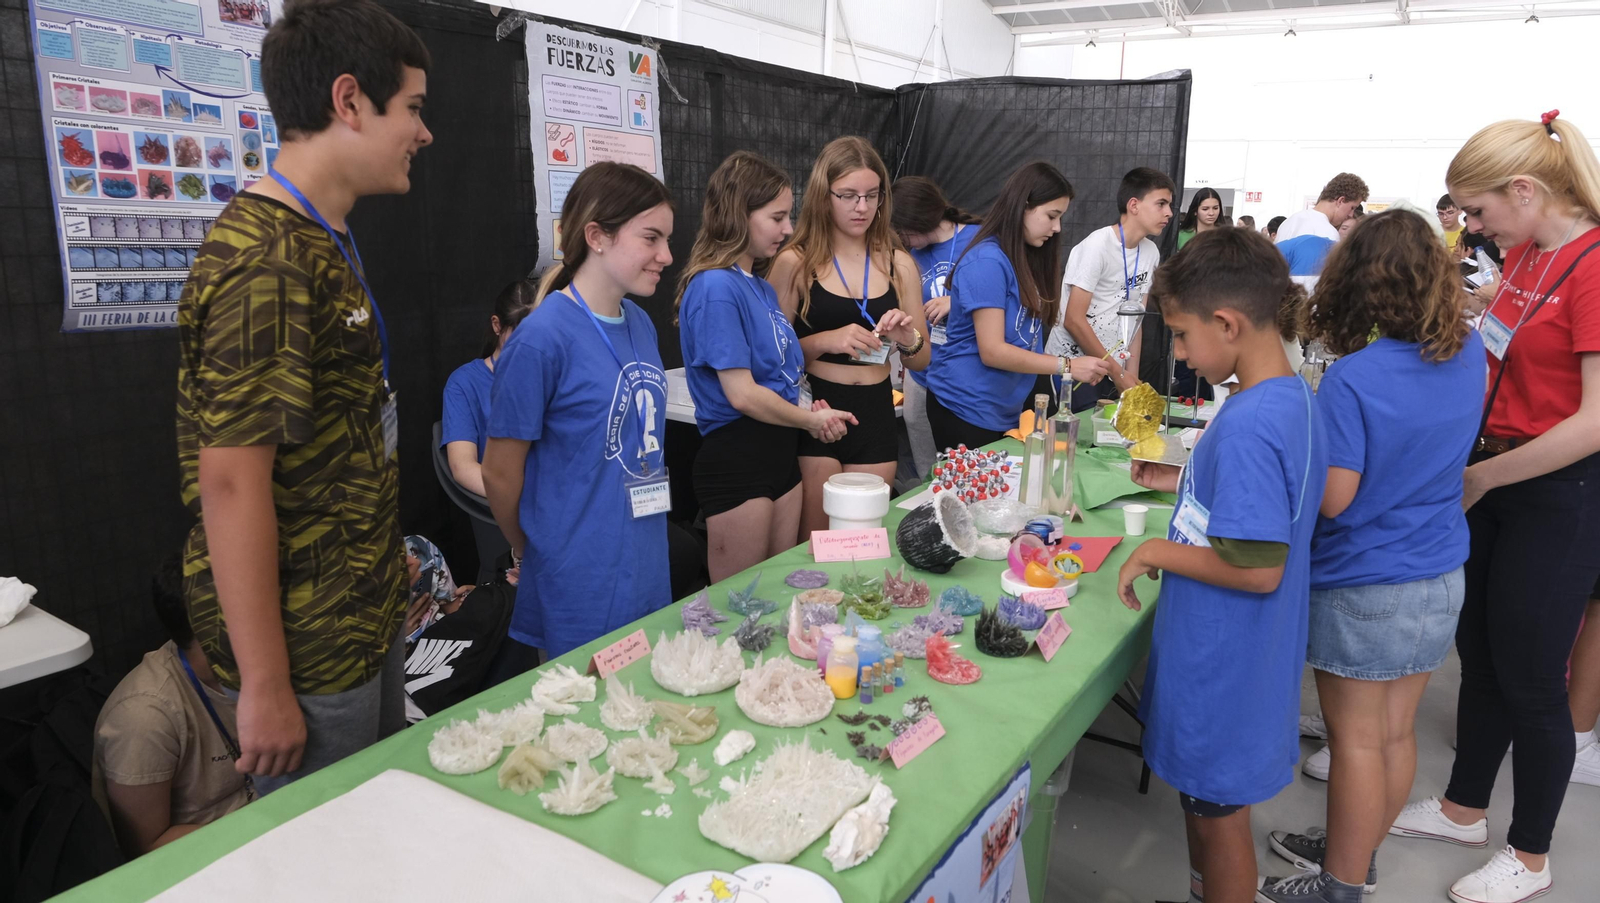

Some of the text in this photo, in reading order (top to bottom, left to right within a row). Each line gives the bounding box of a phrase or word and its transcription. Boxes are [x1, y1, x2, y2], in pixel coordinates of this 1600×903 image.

[40, 21, 67, 31] Objetivos
[84, 22, 118, 32] Observación
[546, 33, 614, 56] DESCUBRIMOS LAS
[547, 46, 615, 77] FUERZAS
[628, 50, 651, 77] VA
[52, 73, 101, 85] Primeros Cristales
[54, 119, 79, 128] Cristales
[90, 122, 119, 131] colorantes
[82, 313, 97, 327] III
[101, 312, 132, 326] FERIA
[137, 311, 151, 324] DE
[154, 311, 166, 323] LA
[610, 416, 621, 452] FERIA
[618, 394, 628, 412] DE
[632, 484, 667, 496] ESTUDIANTE
[404, 638, 474, 675] NIKE
